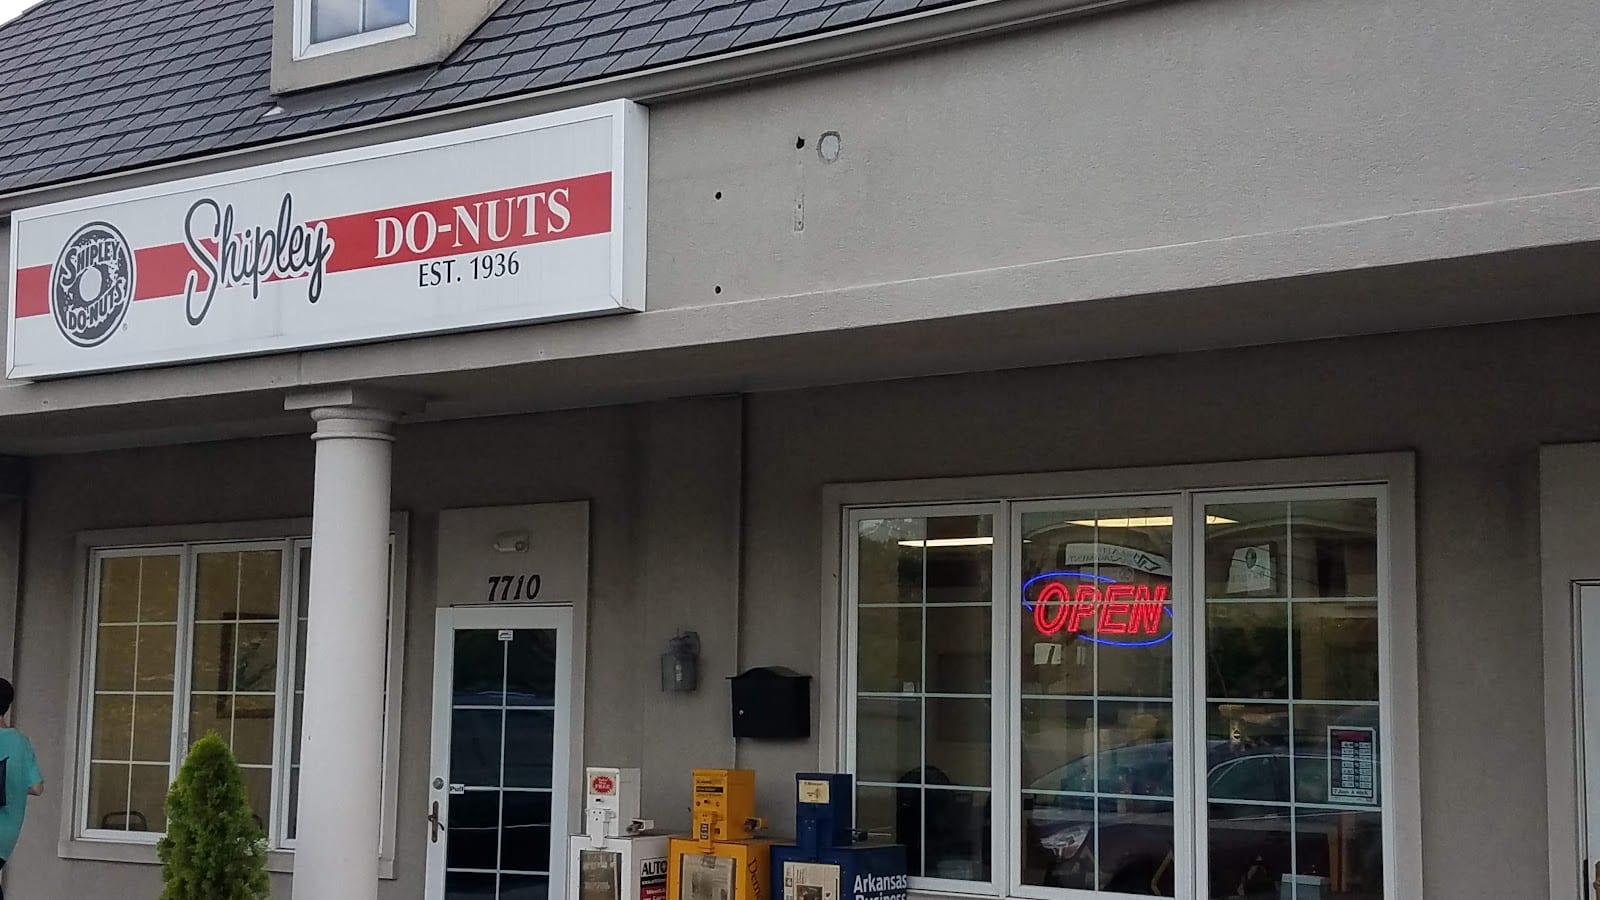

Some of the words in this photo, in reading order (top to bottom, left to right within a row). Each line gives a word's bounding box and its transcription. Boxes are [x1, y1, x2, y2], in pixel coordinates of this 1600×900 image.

[61, 240, 121, 286] SHIPLEY
[184, 193, 331, 326] Shipley
[374, 187, 572, 259] DO-NUTS
[419, 259, 462, 287] EST.
[469, 250, 520, 280] 1936
[488, 574, 541, 602] 7710
[1034, 581, 1168, 637] OPEN
[641, 860, 668, 876] AUTO
[853, 873, 907, 894] Arkansas
